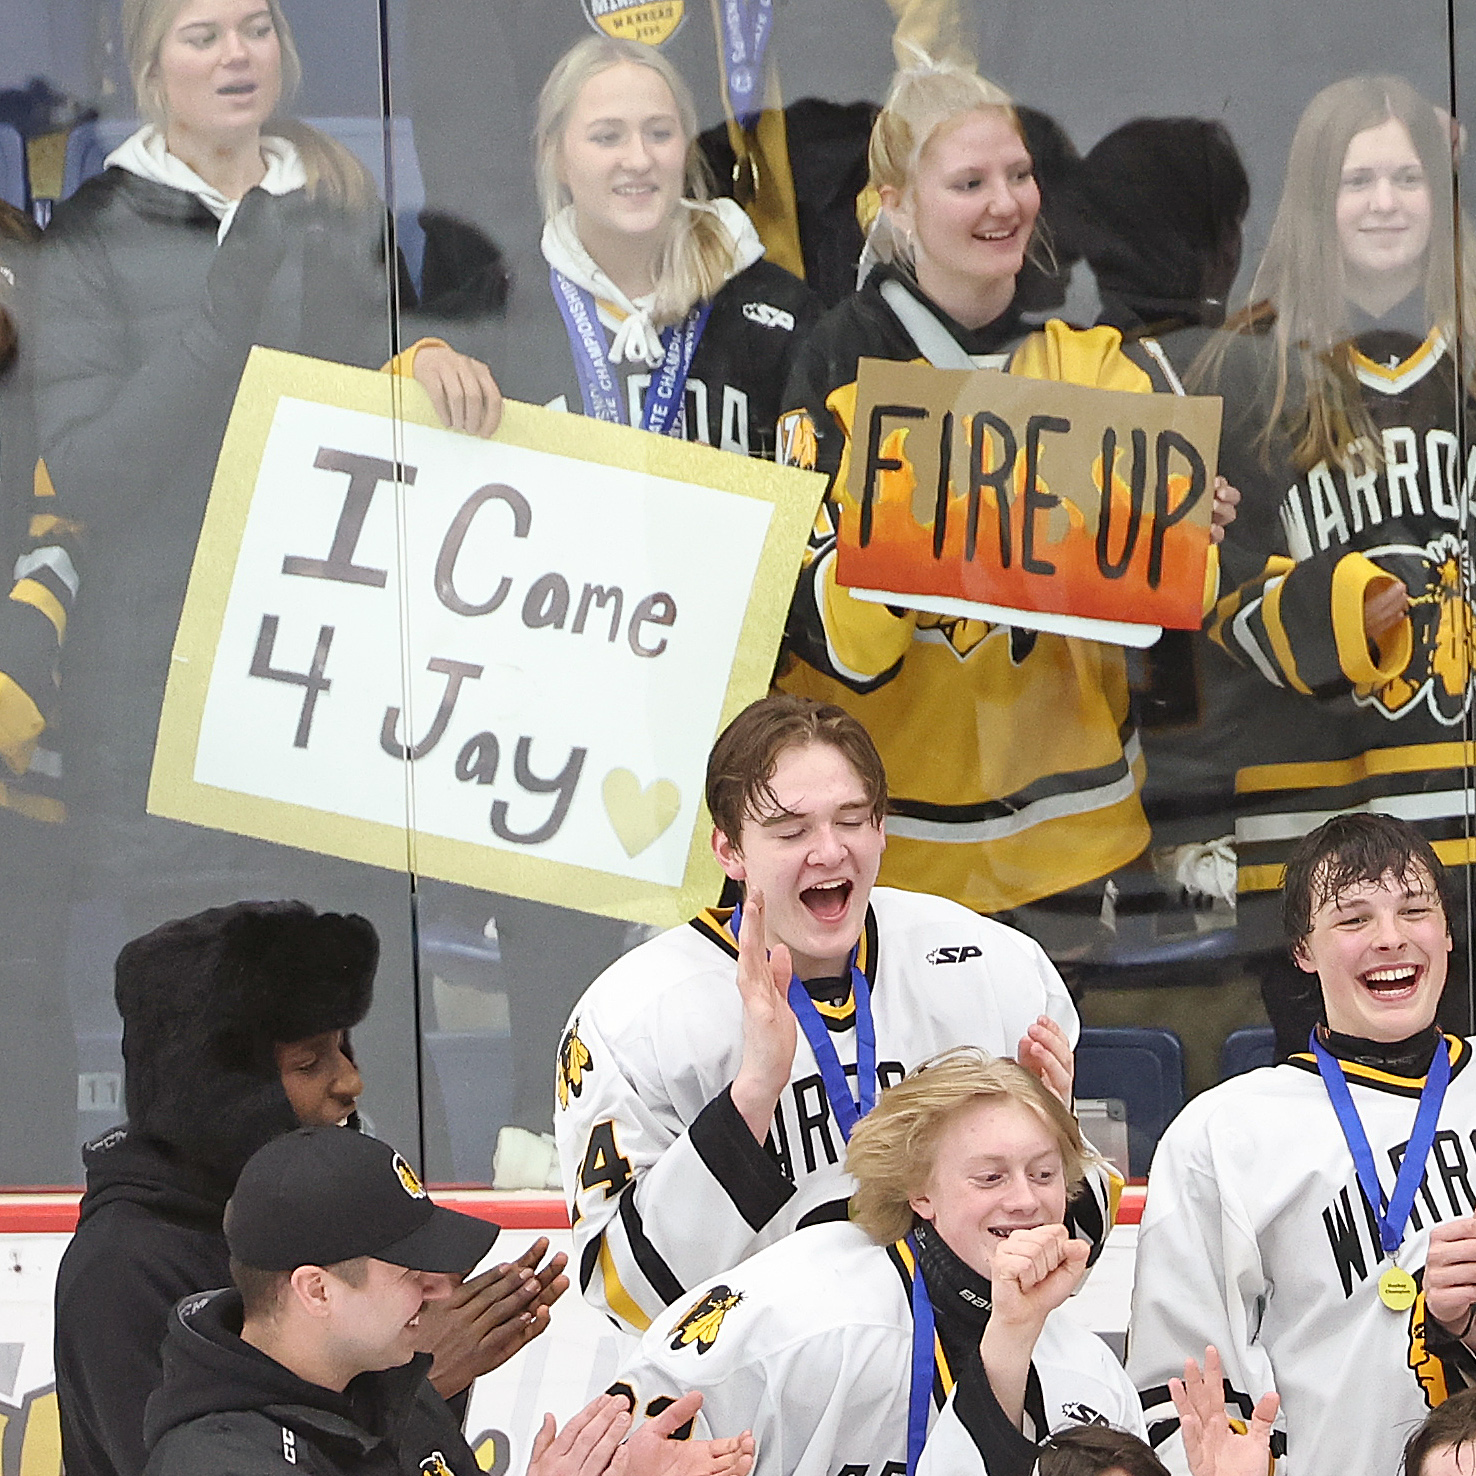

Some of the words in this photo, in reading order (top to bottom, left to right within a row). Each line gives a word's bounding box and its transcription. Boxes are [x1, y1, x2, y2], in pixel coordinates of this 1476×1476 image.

[281, 446, 418, 588] I
[434, 483, 677, 658] Came
[860, 404, 1079, 576] FIRE
[1094, 427, 1206, 589] UP
[248, 614, 335, 748] 4
[379, 659, 588, 844] Jay
[936, 946, 983, 964] SP
